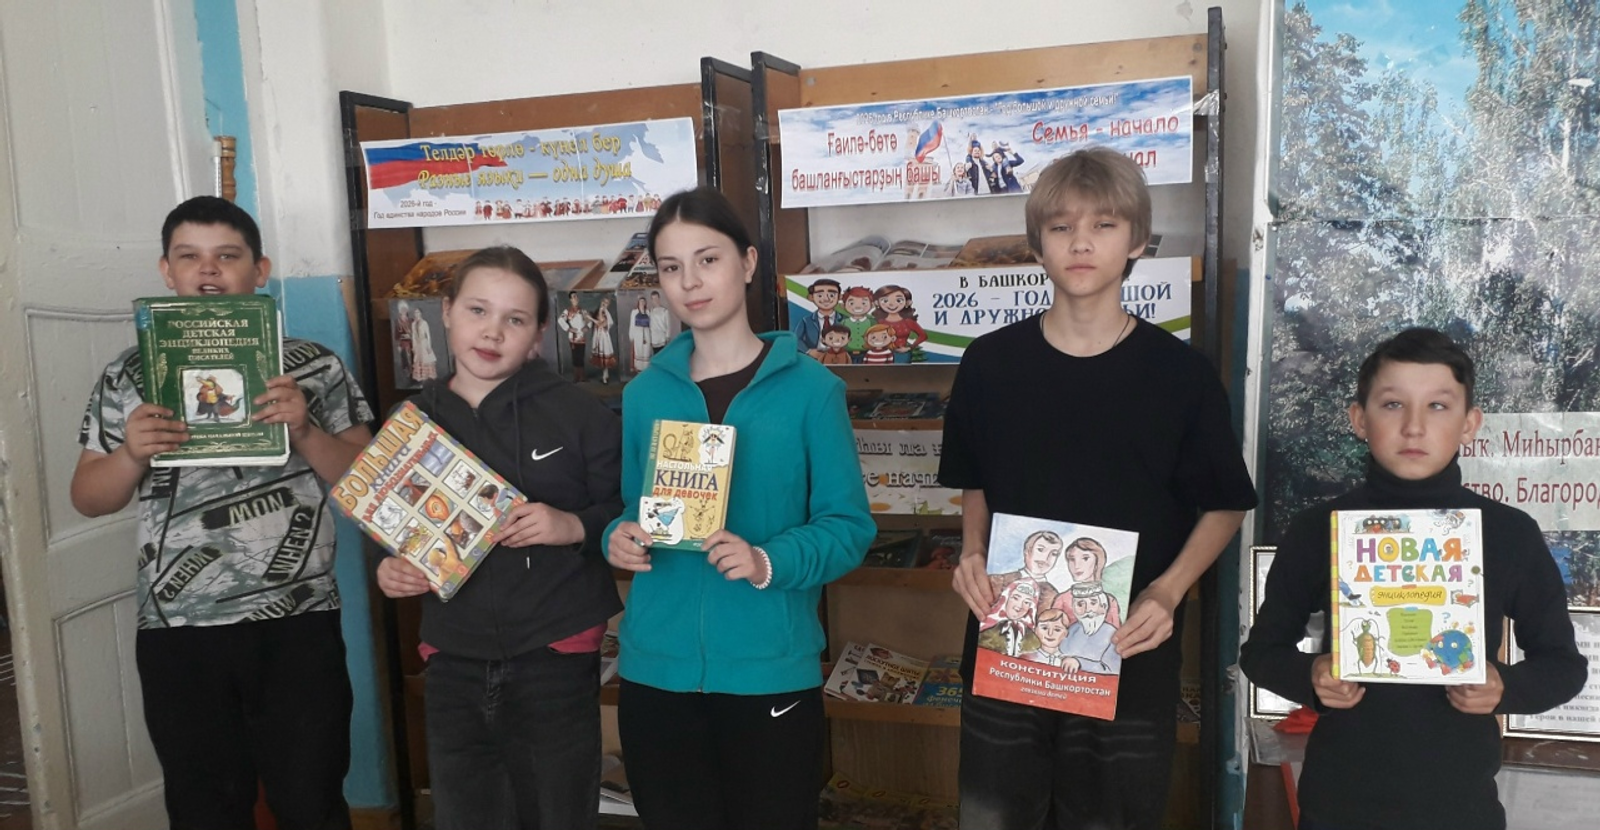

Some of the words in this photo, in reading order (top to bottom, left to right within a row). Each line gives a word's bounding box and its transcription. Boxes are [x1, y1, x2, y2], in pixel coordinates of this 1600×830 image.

[592, 132, 621, 156] бер
[1032, 120, 1089, 144] Семья
[906, 161, 942, 185] башы
[978, 273, 1049, 288] БАШКОР
[932, 292, 979, 309] 2026
[1013, 290, 1052, 307] ГОД
[1120, 281, 1172, 302] ШОЙ
[167, 317, 249, 329] РОССИЙСКАЯ
[934, 310, 949, 326] И
[1123, 302, 1156, 319] ЬИ!
[159, 338, 259, 348] ЭНЦИКЛОПЕДИЯ
[182, 328, 236, 339] ДЕТСКАЯ
[332, 407, 425, 511] БОЛЬШАЯ
[1458, 438, 1494, 458] ыҡ.
[655, 469, 719, 492] КНИГА
[1517, 477, 1600, 511] Благоро
[1356, 536, 1464, 563] НОВАЯ
[1354, 564, 1463, 583] ДЕТСКАЯ
[989, 667, 1043, 688] Республики
[1044, 680, 1111, 697] Башкортостан
